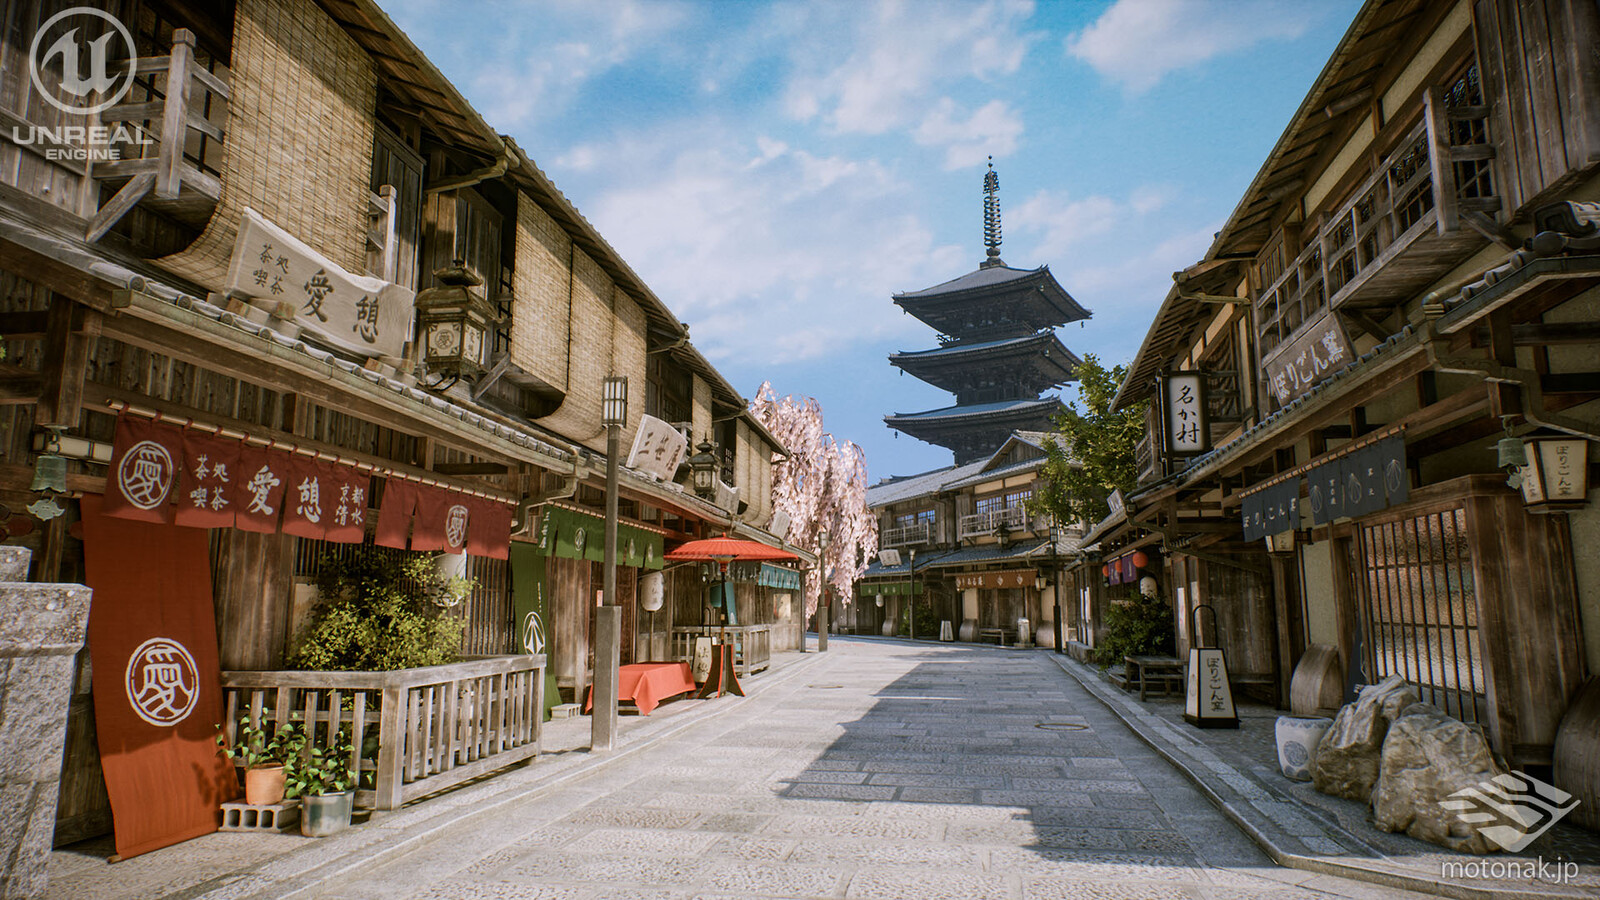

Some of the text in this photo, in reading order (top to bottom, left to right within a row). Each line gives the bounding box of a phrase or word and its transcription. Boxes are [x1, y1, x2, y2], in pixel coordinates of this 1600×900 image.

[259, 243, 289, 274] 茶処
[252, 267, 285, 295] 喫茶
[301, 268, 380, 344] 愛憩
[1174, 385, 1200, 444] 名か村
[194, 453, 230, 483] 茶処
[189, 485, 229, 512] 喫茶
[245, 464, 322, 523] 愛憩
[339, 482, 364, 506] 京都
[334, 503, 363, 527] 清水
